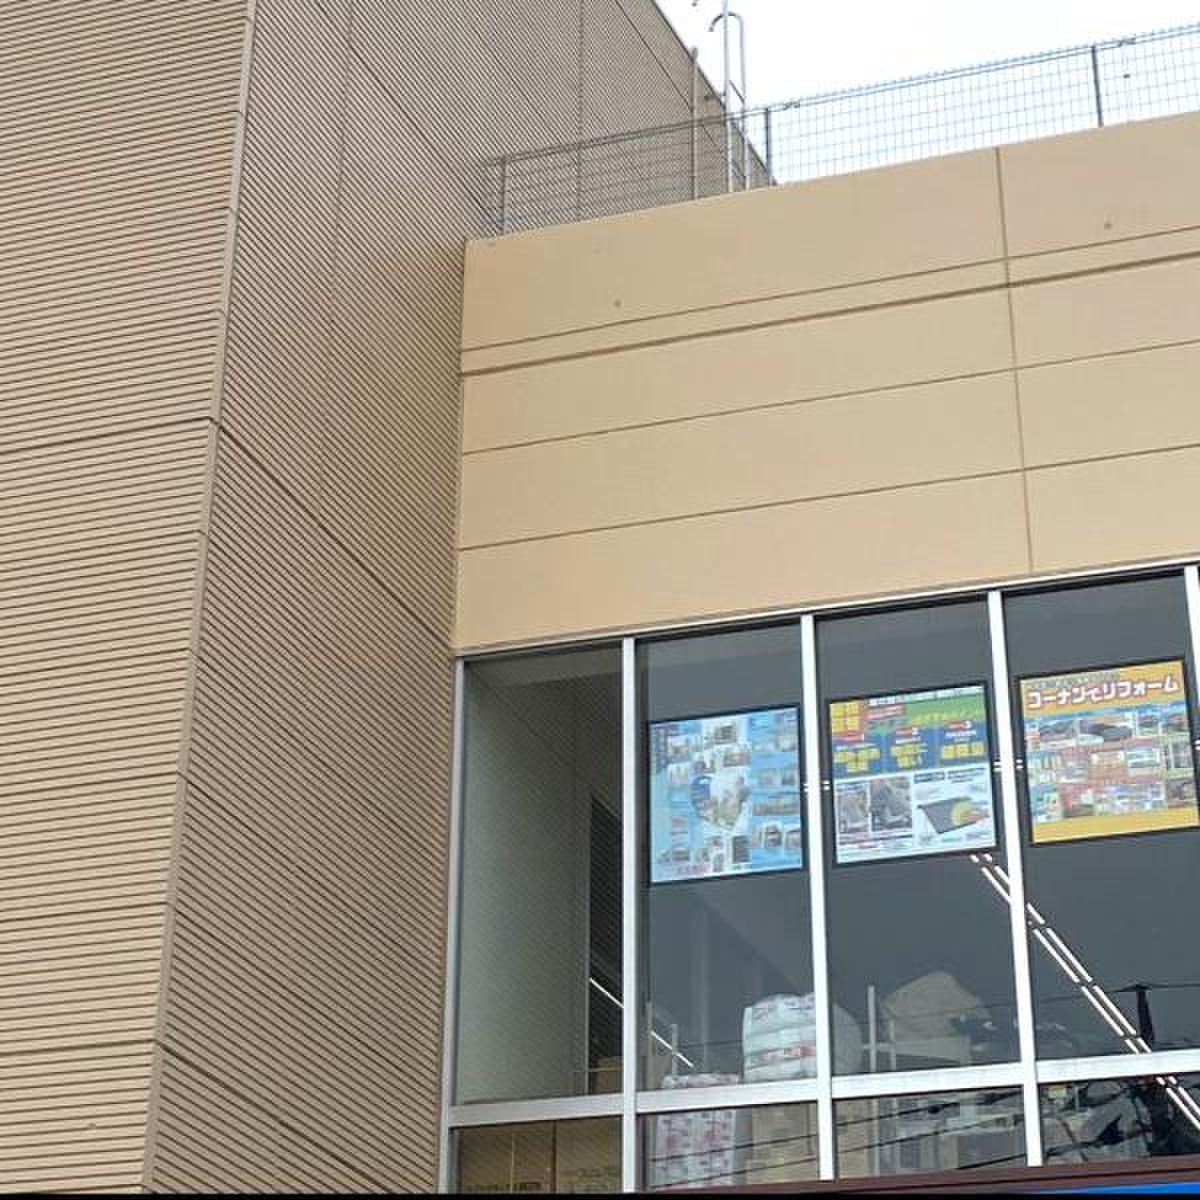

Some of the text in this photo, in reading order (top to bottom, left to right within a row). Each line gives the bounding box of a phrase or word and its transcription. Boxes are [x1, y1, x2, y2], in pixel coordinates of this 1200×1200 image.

[1028, 675, 1179, 709] コーナンでリフォーム
